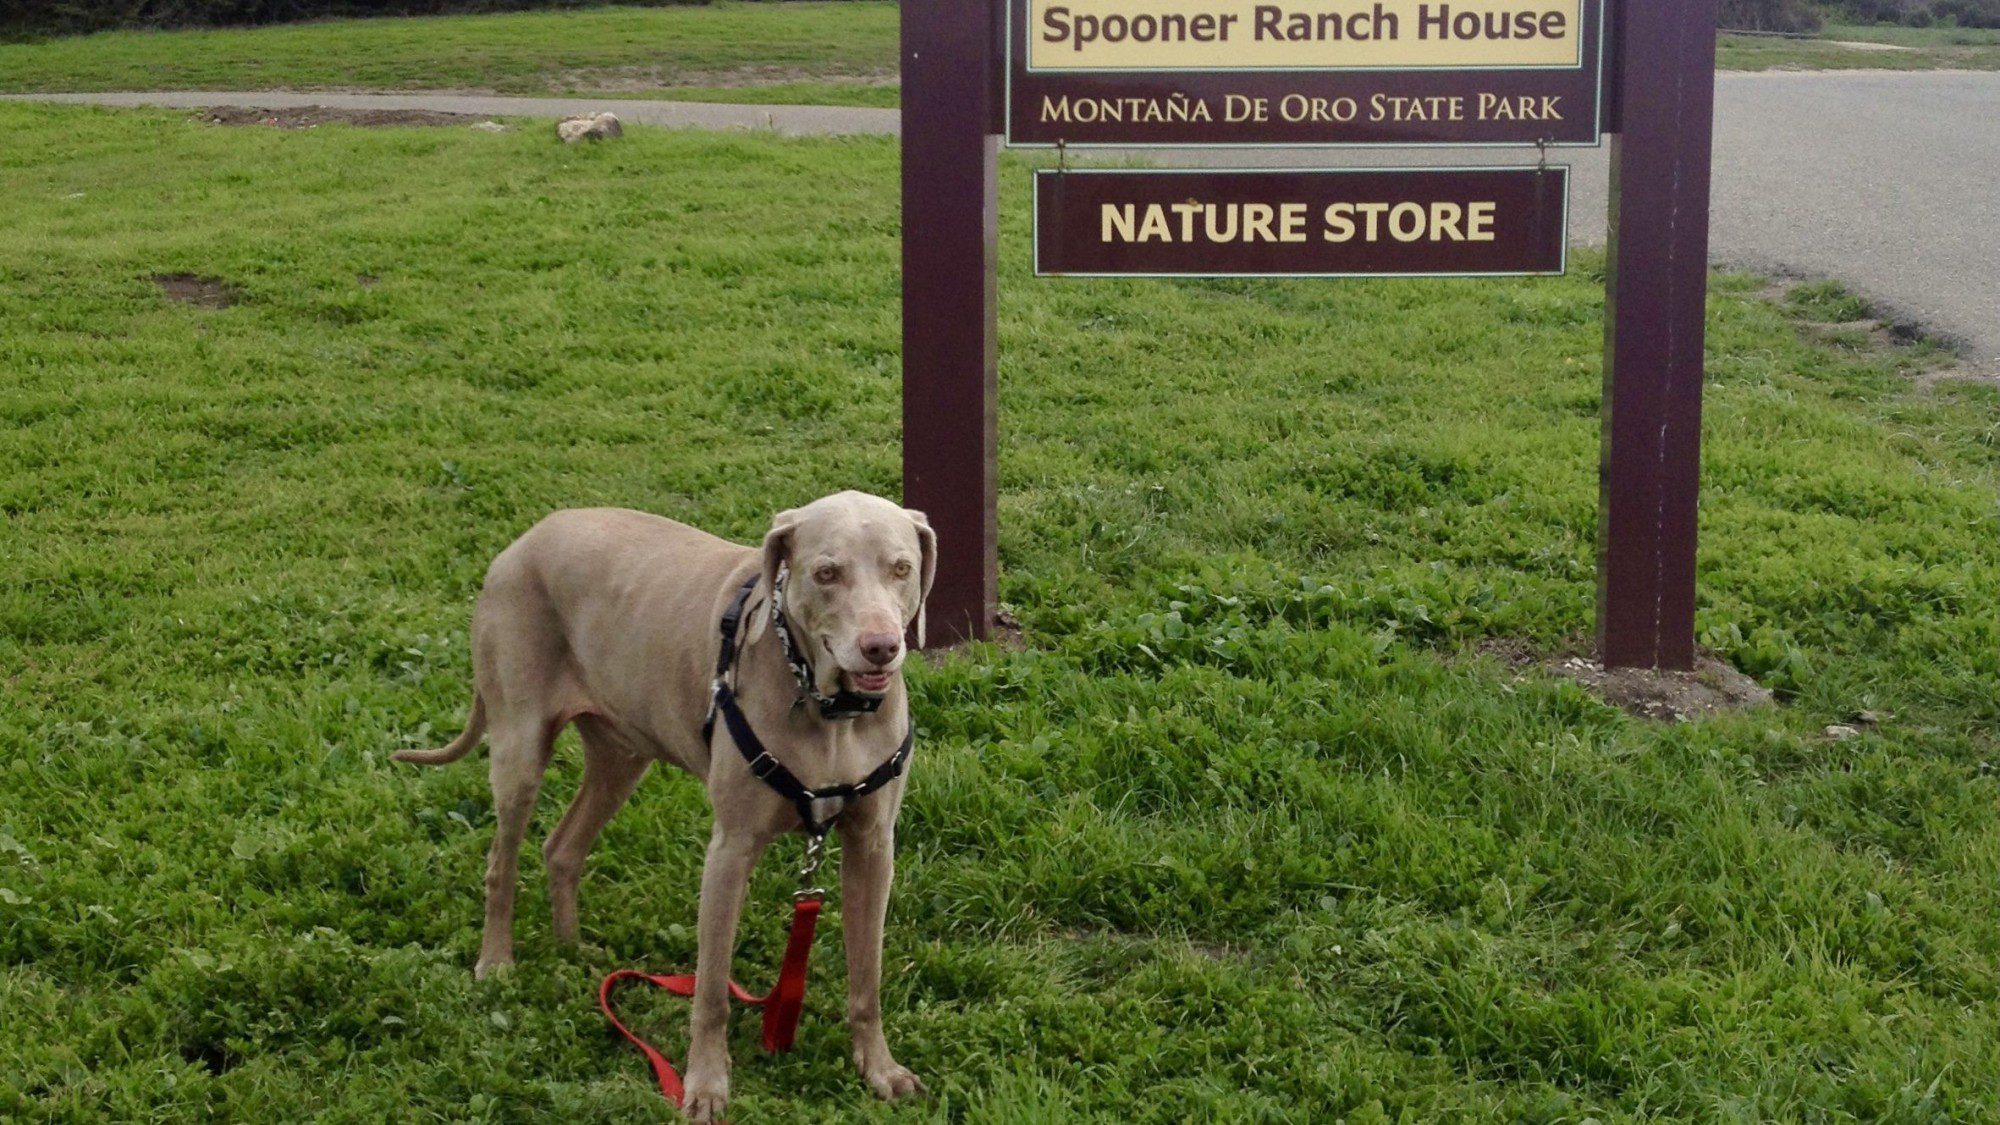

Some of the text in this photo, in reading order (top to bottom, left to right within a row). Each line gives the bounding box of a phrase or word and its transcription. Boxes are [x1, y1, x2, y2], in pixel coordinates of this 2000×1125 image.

[1042, 2, 1567, 52] Spooner Ranch House
[1040, 92, 1564, 123] MONTAÑA DE ORO STATE PARK
[1101, 201, 1496, 243] NATURE STORE
